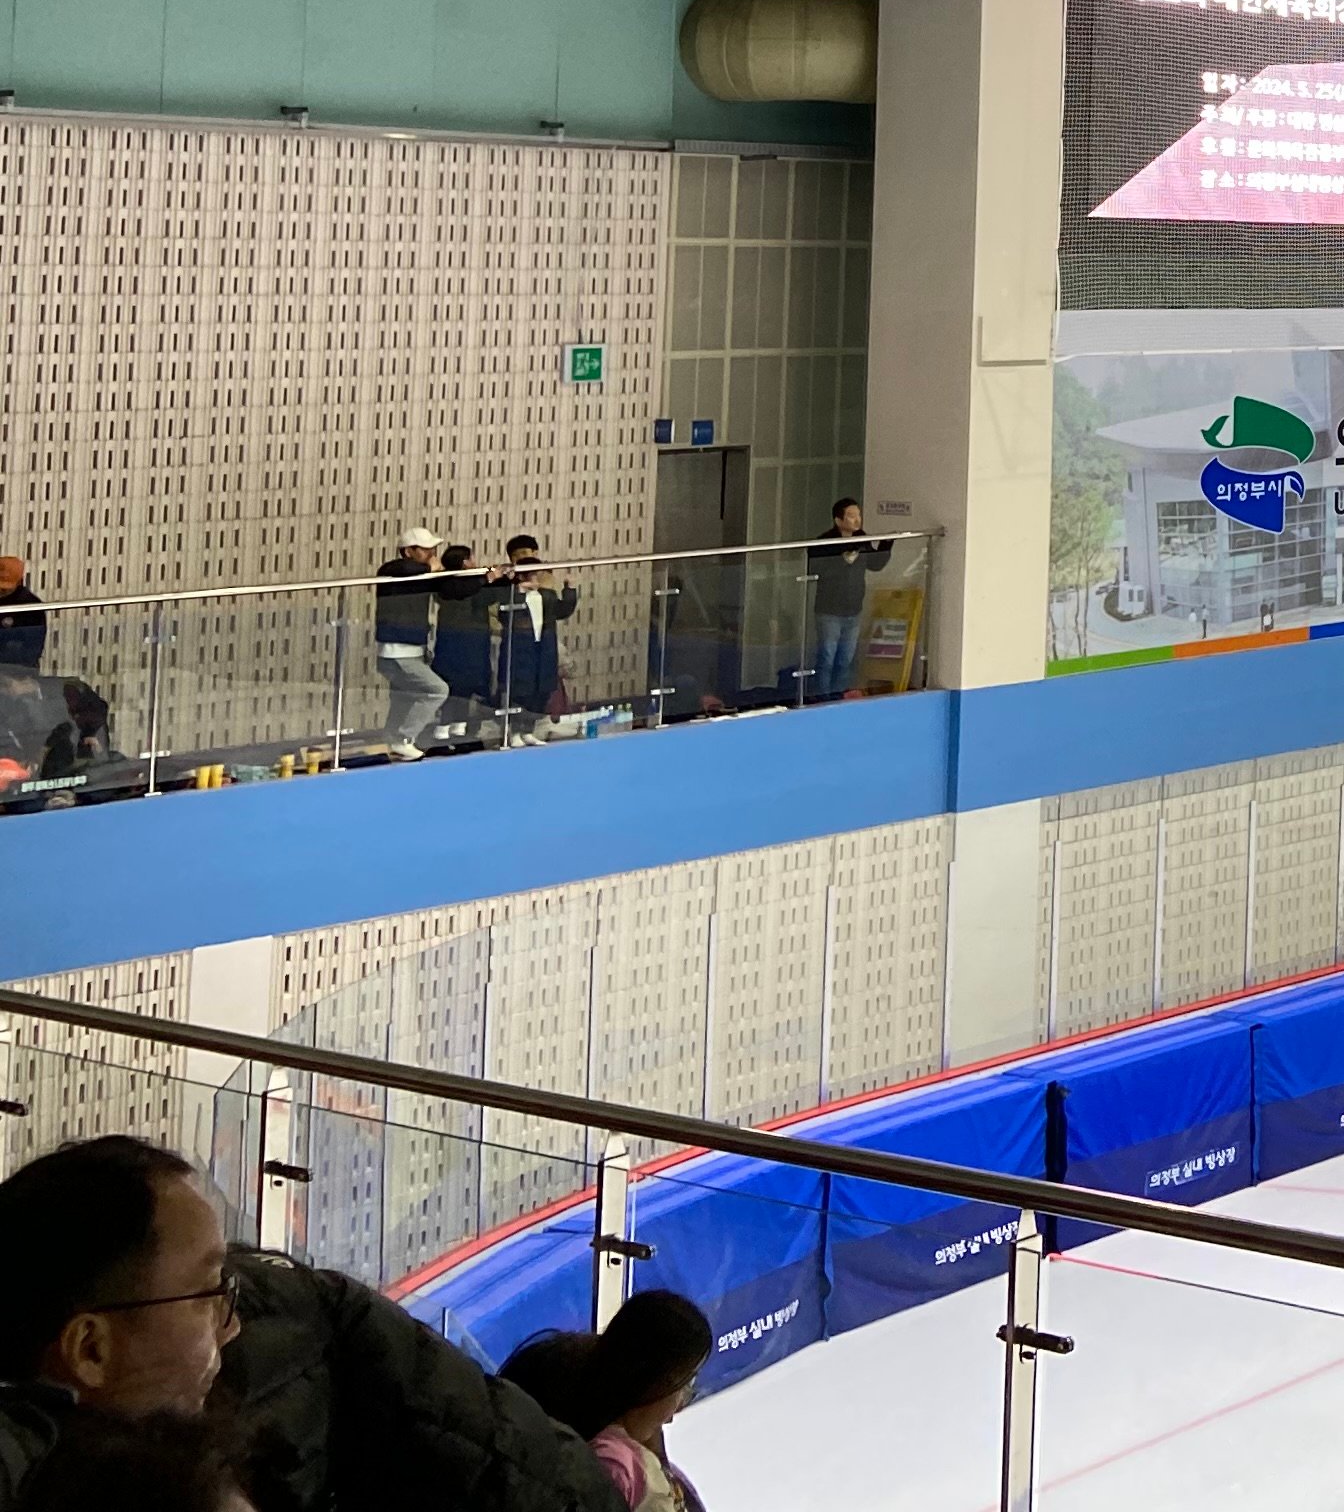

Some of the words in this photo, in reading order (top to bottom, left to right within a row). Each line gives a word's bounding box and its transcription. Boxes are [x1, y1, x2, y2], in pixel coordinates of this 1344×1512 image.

[1216, 480, 1283, 503] 의정부시
[1150, 1166, 1180, 1187] 의정부
[1182, 1157, 1203, 1178] 실내
[1205, 1146, 1235, 1170] 빙상장
[935, 1239, 967, 1265] 의정부
[718, 1325, 748, 1352] 의정부
[749, 1315, 774, 1339] 실내
